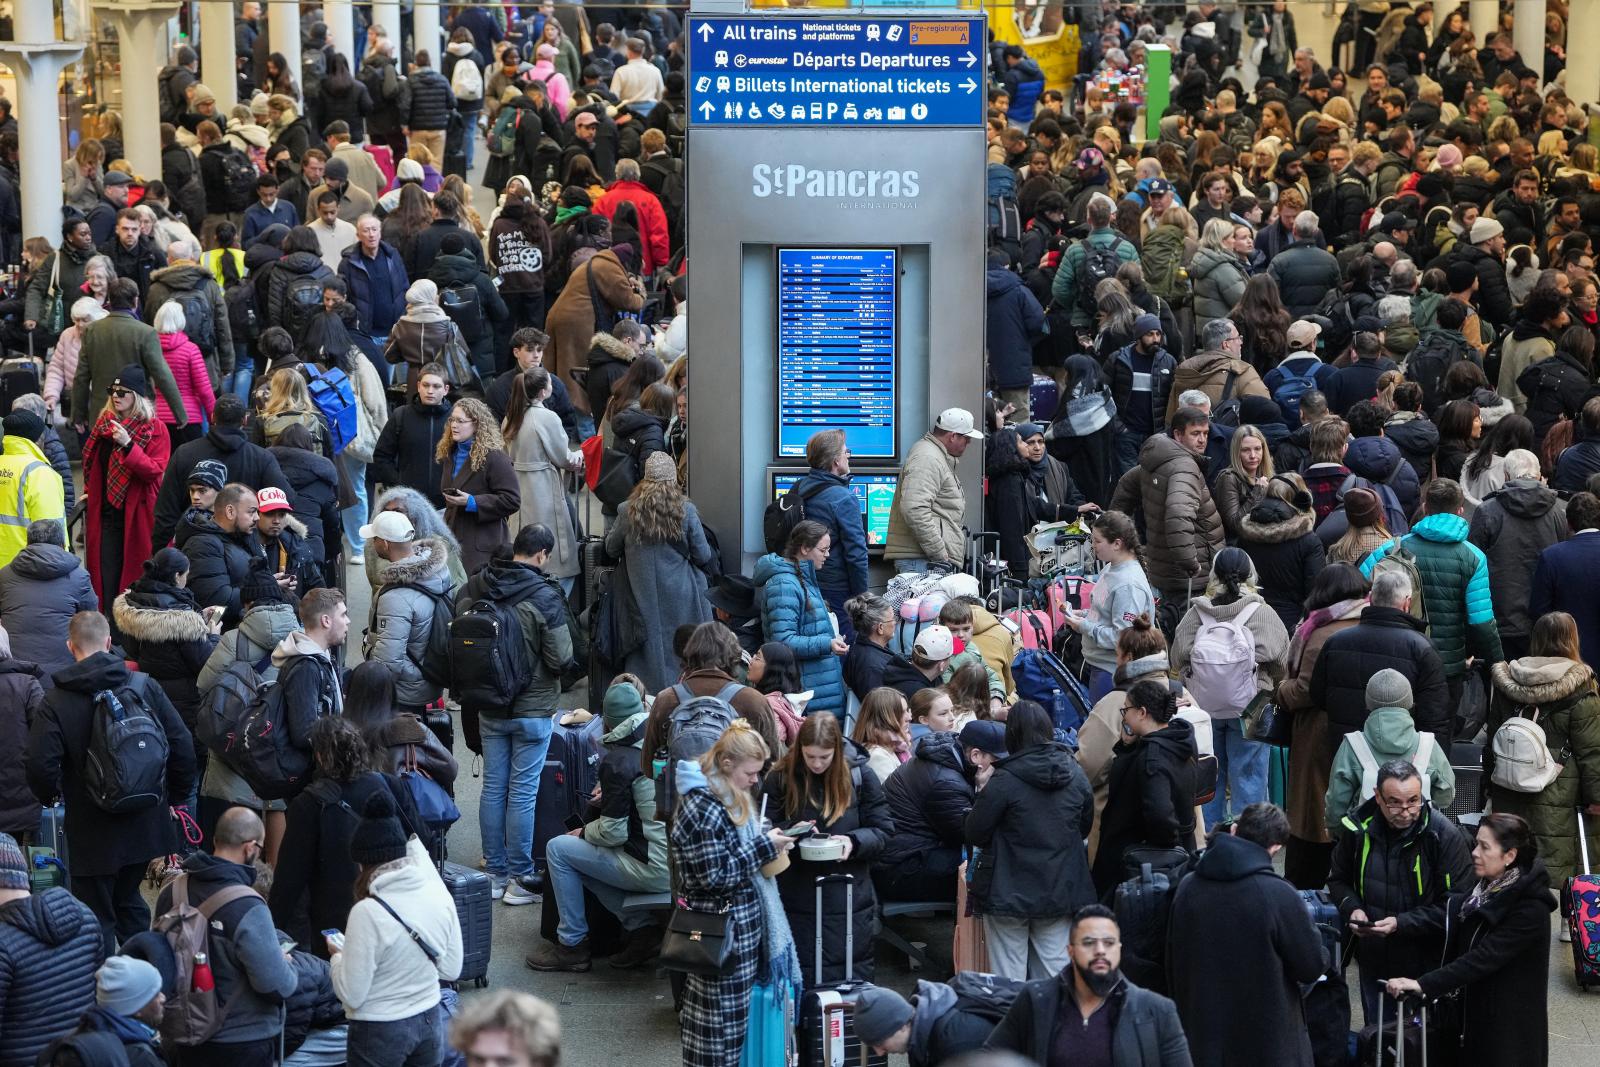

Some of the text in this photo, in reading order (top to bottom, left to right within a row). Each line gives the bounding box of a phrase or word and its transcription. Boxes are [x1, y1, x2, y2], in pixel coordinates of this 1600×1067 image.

[802, 23, 861, 32] National tickets
[911, 24, 968, 34] Pre-registration
[723, 25, 797, 41] All trains
[802, 32, 855, 42] and platforms
[959, 33, 968, 43] A
[748, 56, 788, 66] eurostar
[793, 52, 951, 71] Départs Departures
[735, 77, 951, 94] Billets International tickets
